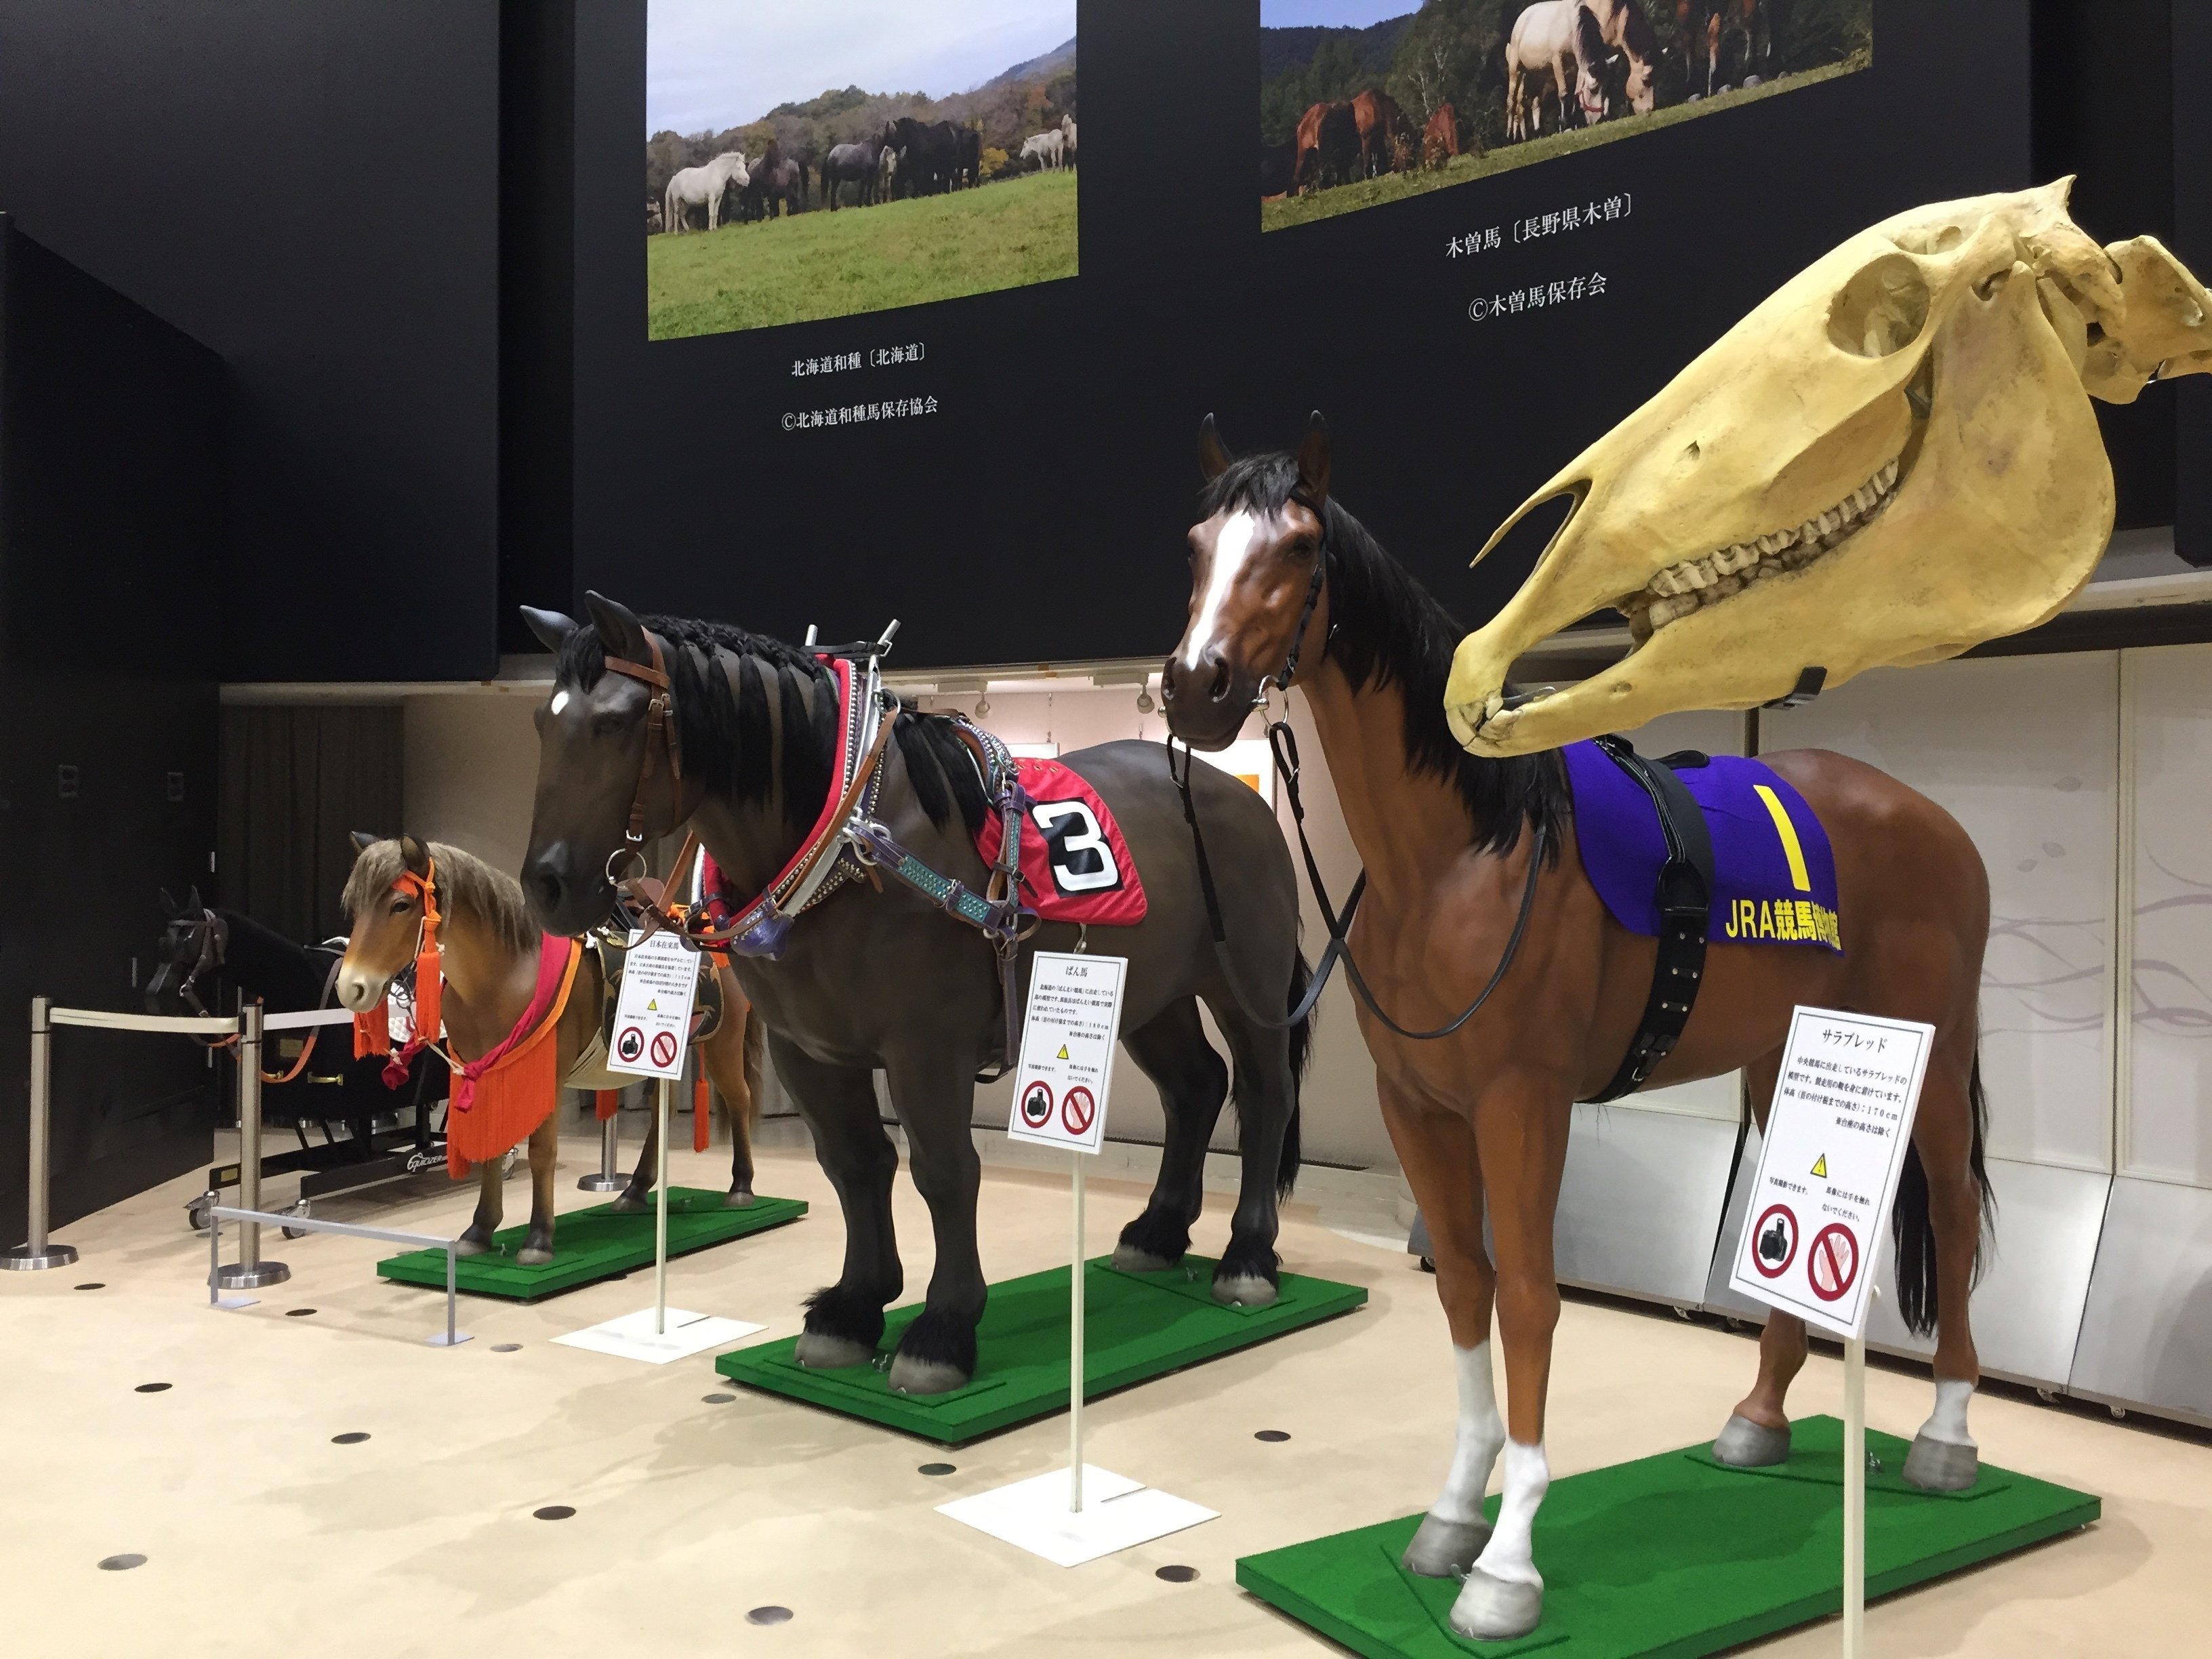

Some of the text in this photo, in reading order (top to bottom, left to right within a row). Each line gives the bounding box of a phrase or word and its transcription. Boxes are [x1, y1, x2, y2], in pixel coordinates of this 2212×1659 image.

[1032, 801, 1118, 891] 3
[1753, 785, 1811, 891] 1
[1822, 1029, 1887, 1052] サラブレッド
